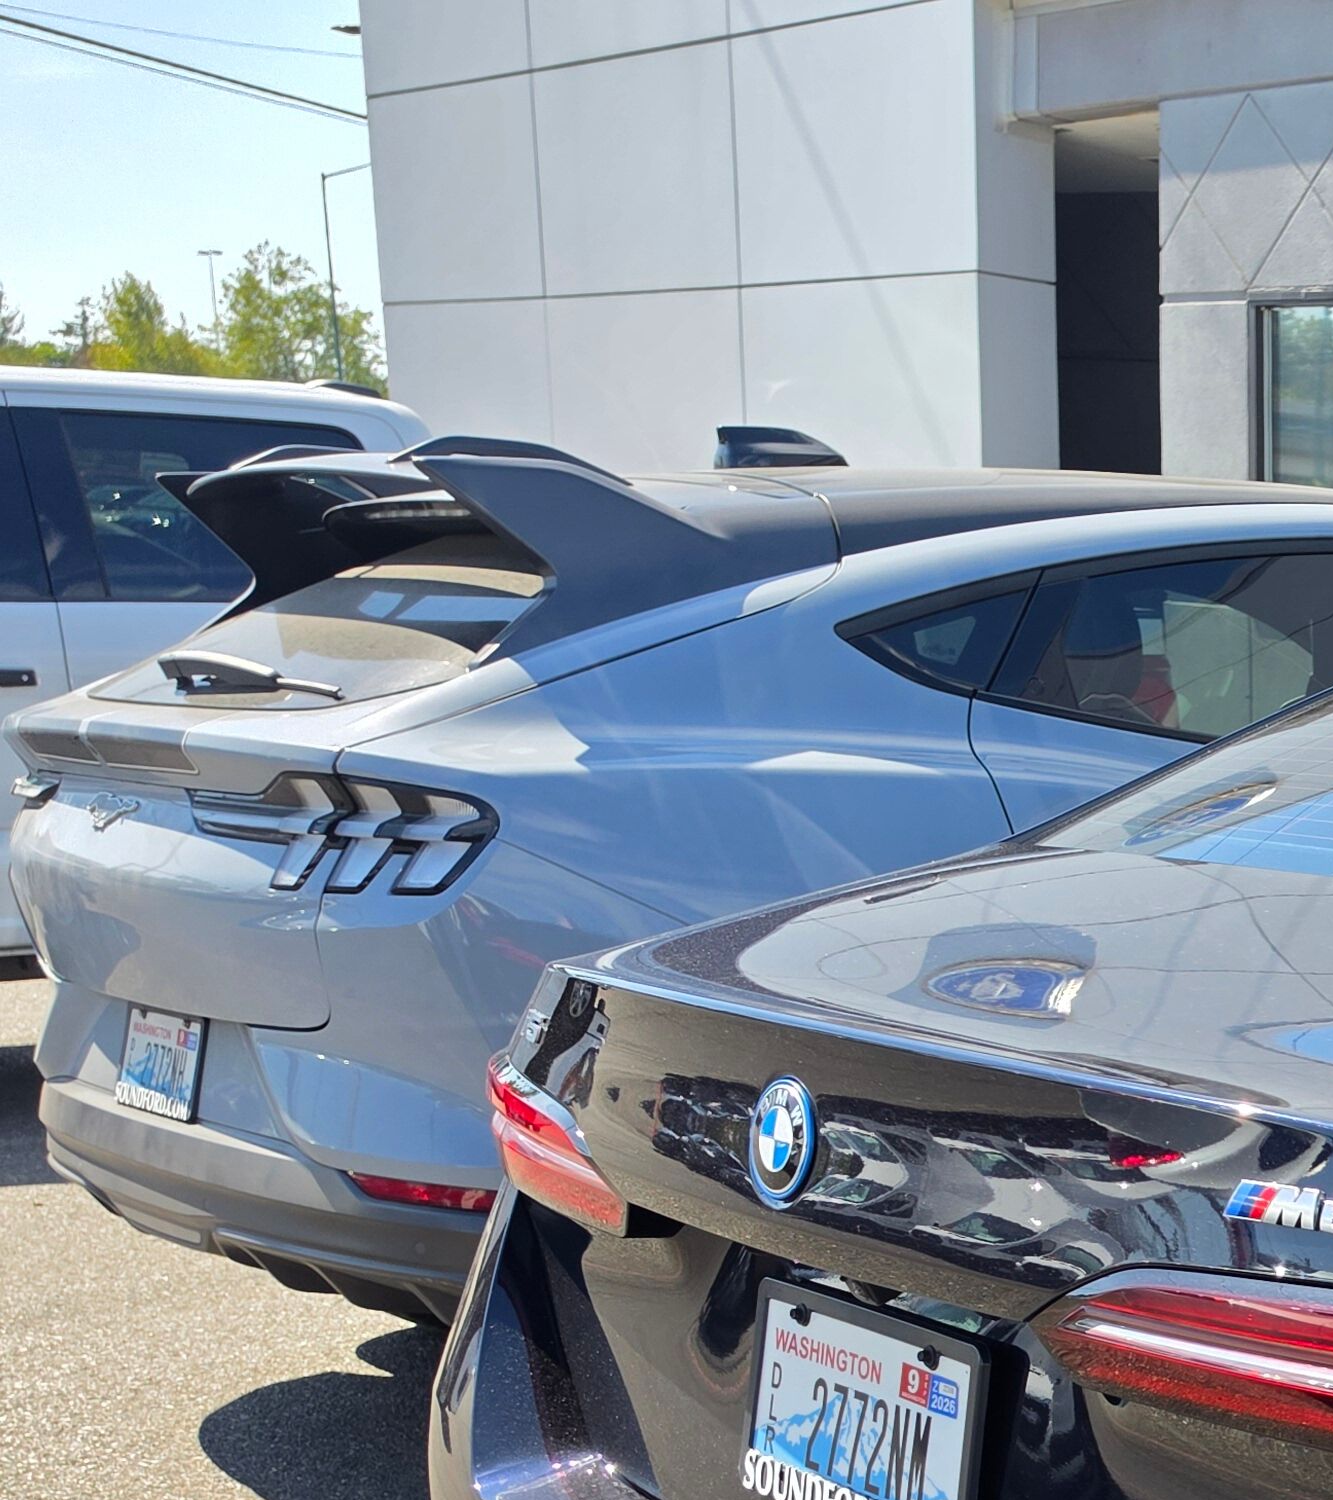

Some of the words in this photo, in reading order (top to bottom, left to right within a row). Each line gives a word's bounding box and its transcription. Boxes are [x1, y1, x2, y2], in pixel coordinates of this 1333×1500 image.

[133, 1021, 172, 1041] WASHINGTON
[114, 1081, 189, 1122] SOUNDFORD.COM
[760, 1089, 803, 1127] BMW
[775, 1327, 882, 1385] WASHINGTON
[907, 1369, 920, 1394] 9
[931, 1394, 956, 1415] 2026
